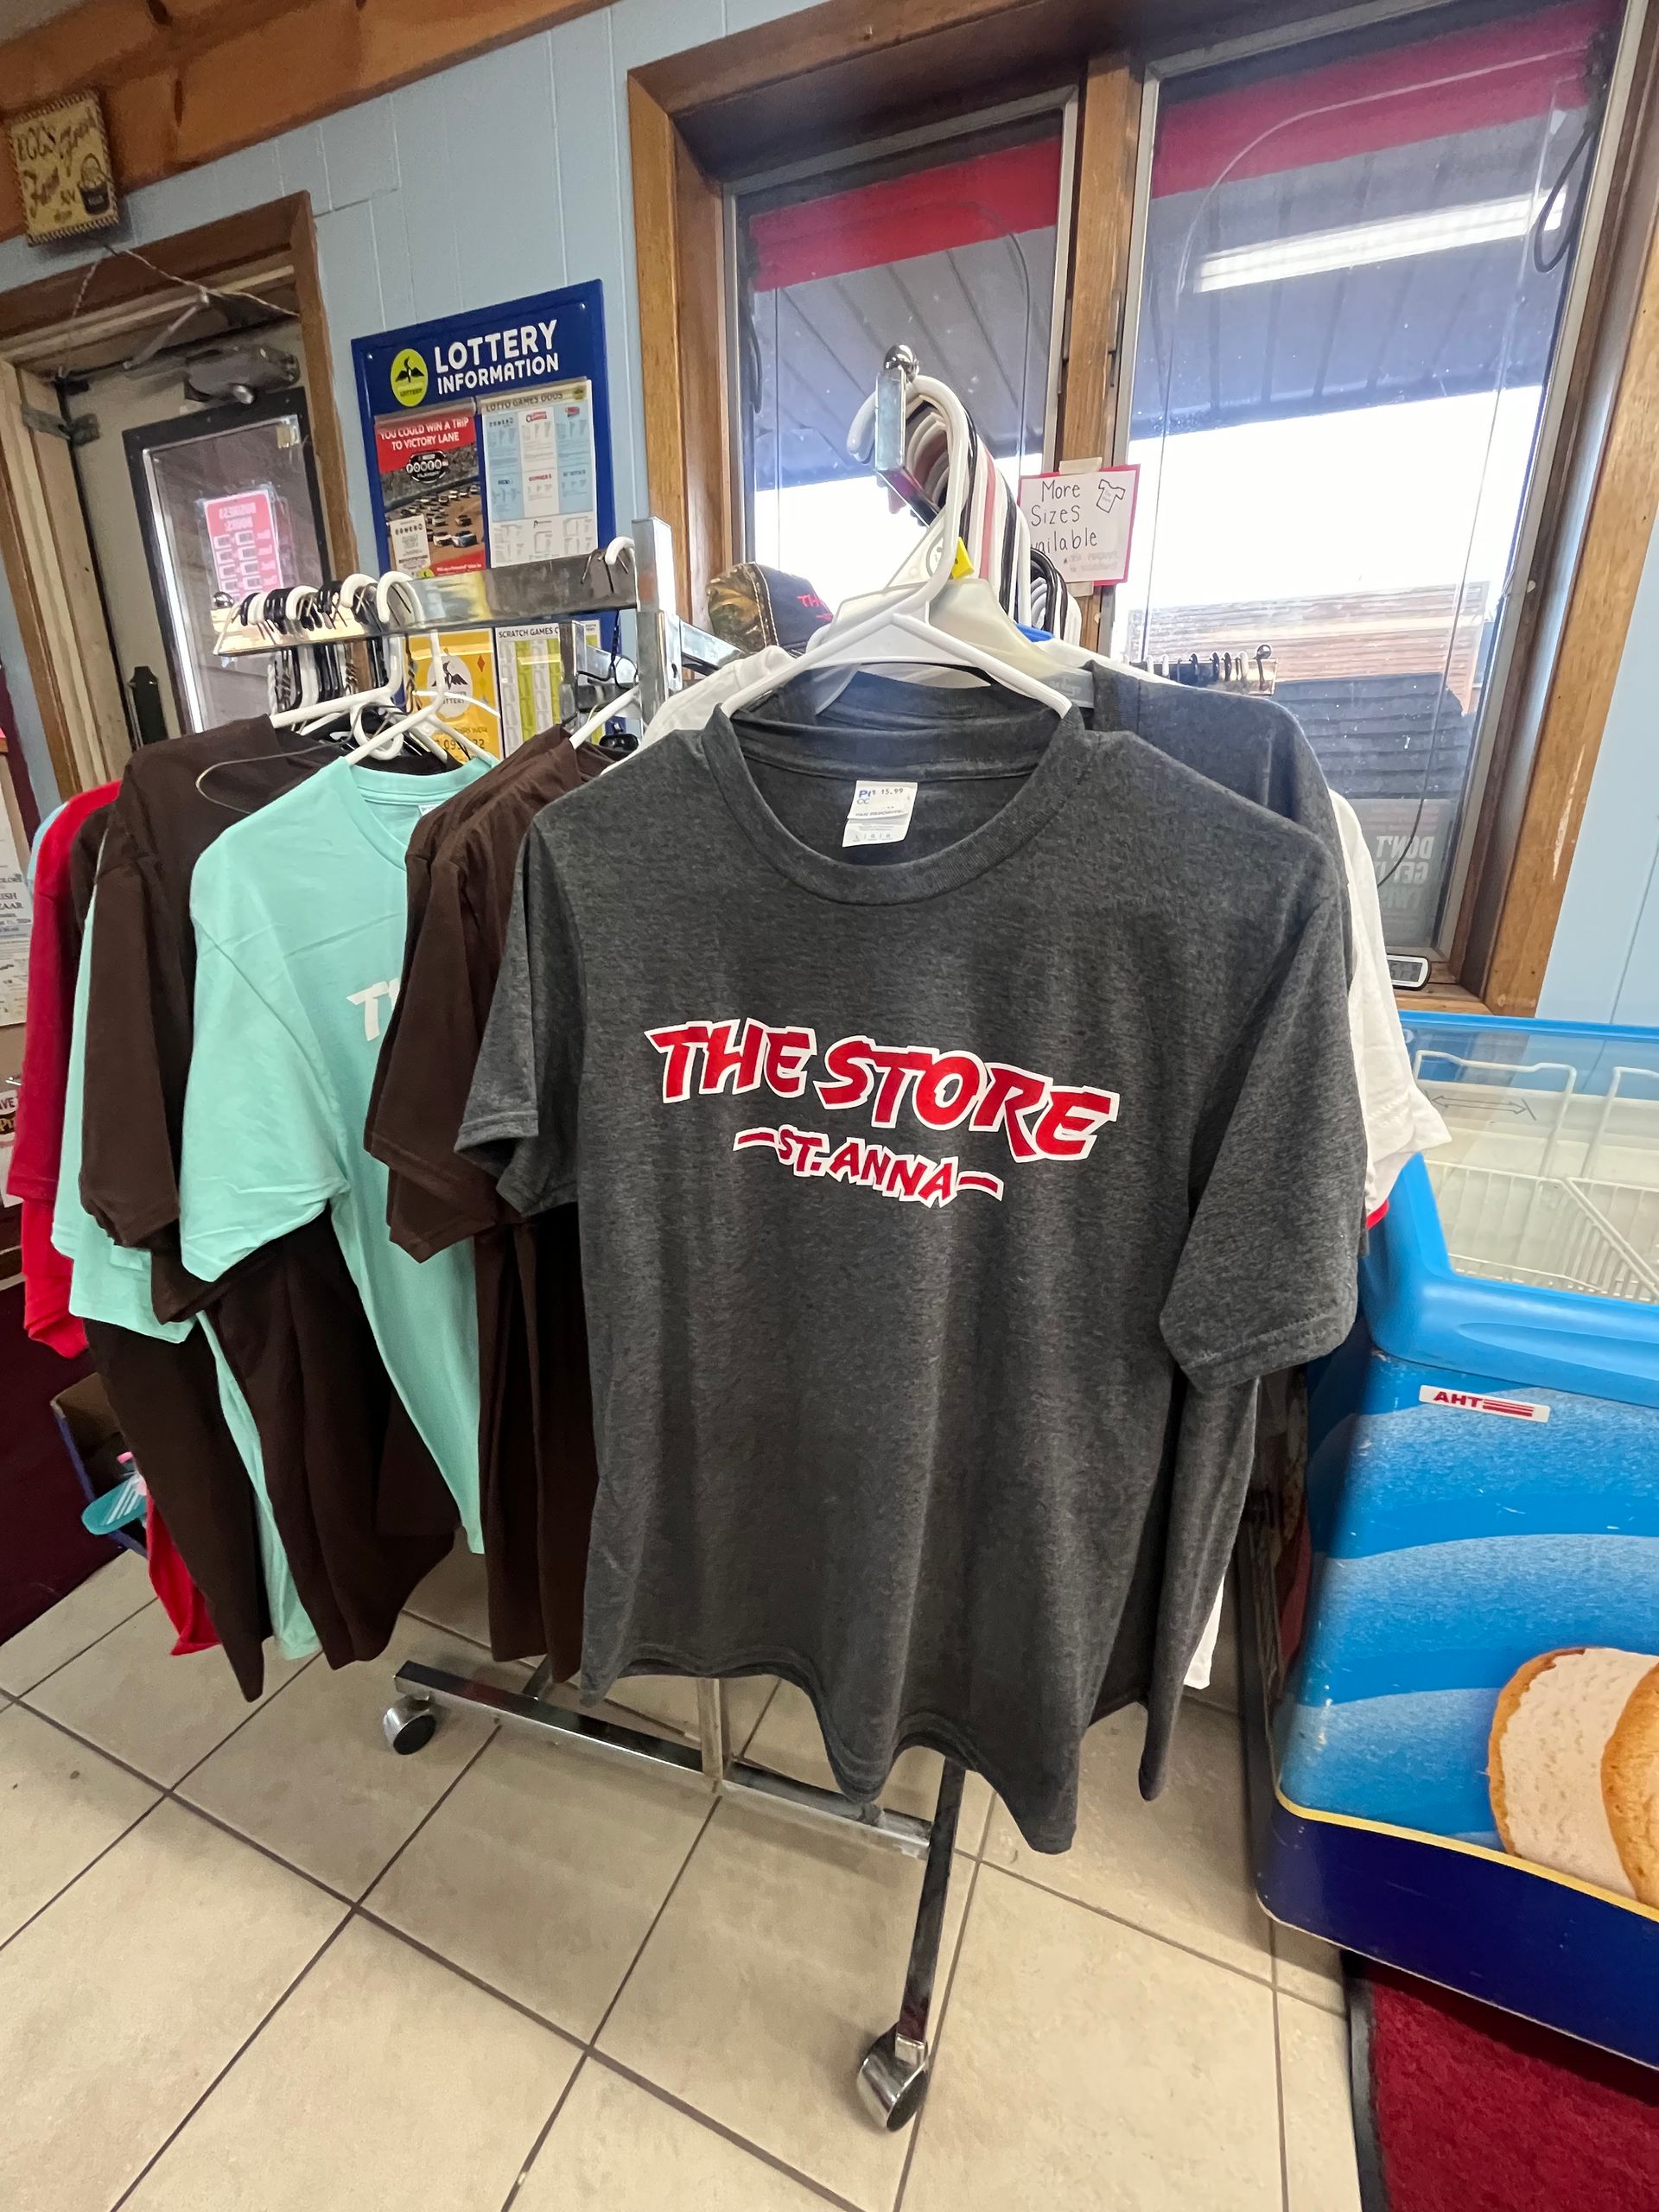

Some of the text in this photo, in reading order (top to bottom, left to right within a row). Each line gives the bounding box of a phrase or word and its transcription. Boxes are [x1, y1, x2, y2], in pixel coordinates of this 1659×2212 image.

[434, 319, 557, 373] LOTTERY
[437, 353, 559, 395] INFORMATION
[512, 397, 539, 407] GAMES
[380, 416, 469, 440] YOU COULD WIN A TRIP
[391, 432, 459, 450] TO VICTORY LANE
[1041, 480, 1080, 502] More
[1031, 505, 1080, 526] Sizes
[1030, 527, 1097, 553] vailable
[499, 629, 528, 638] SCRATCH
[530, 627, 553, 636] GAMES
[346, 977, 401, 1042] T
[645, 1018, 1120, 1163] THE STORE
[1433, 1391, 1483, 1408] AHT
